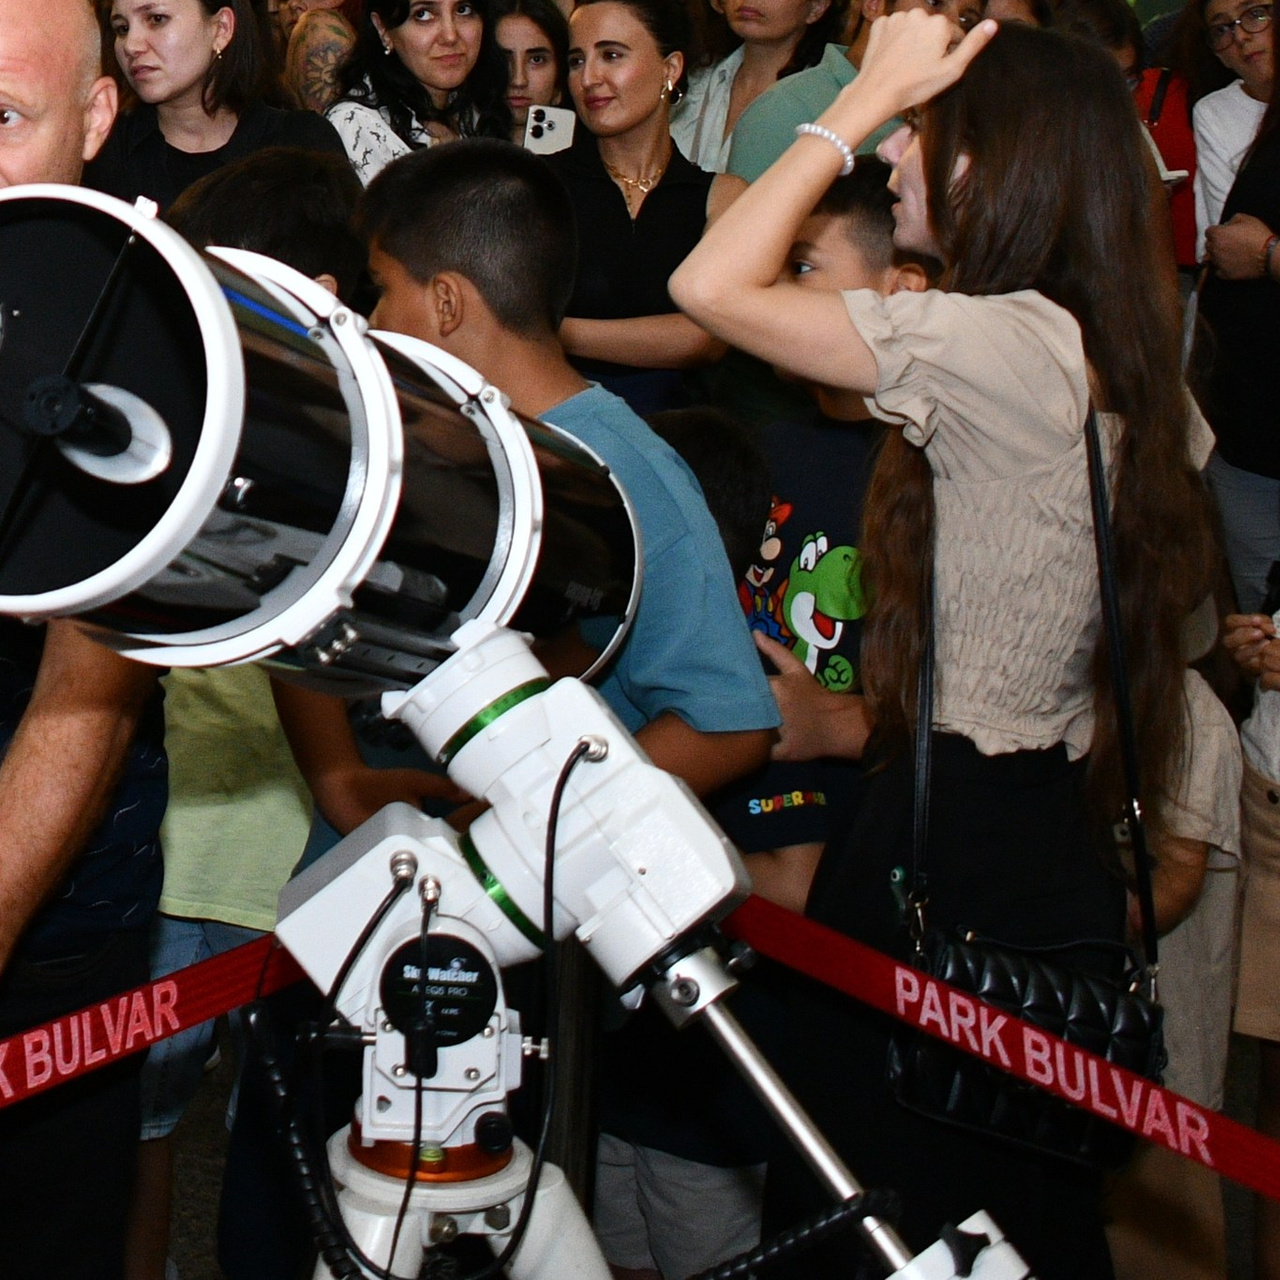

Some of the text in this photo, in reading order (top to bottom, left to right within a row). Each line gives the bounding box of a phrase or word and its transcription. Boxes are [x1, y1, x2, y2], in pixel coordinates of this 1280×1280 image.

[748, 791, 804, 814] SUPER
[23, 979, 180, 1088] BULVAR
[894, 965, 1215, 1166] PARK BULVAR
